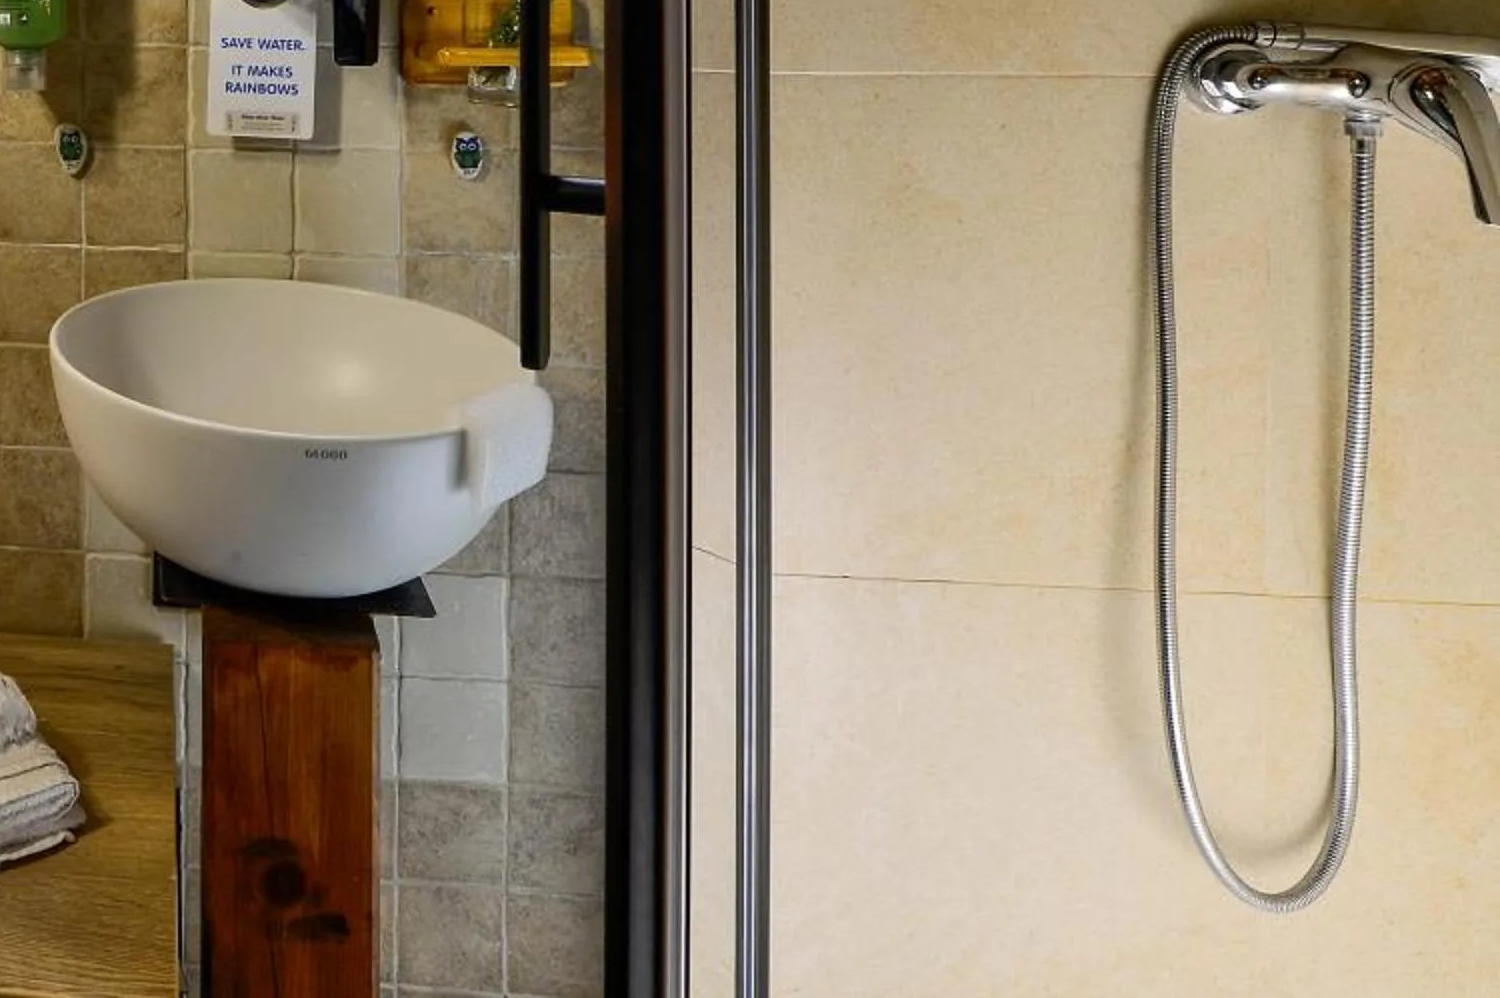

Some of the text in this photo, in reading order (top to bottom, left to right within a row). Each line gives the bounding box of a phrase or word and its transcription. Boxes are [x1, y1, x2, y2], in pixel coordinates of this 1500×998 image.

[221, 37, 254, 49] SAVE
[231, 65, 293, 78] IT MAKES
[225, 82, 299, 96] RAINBOWS
